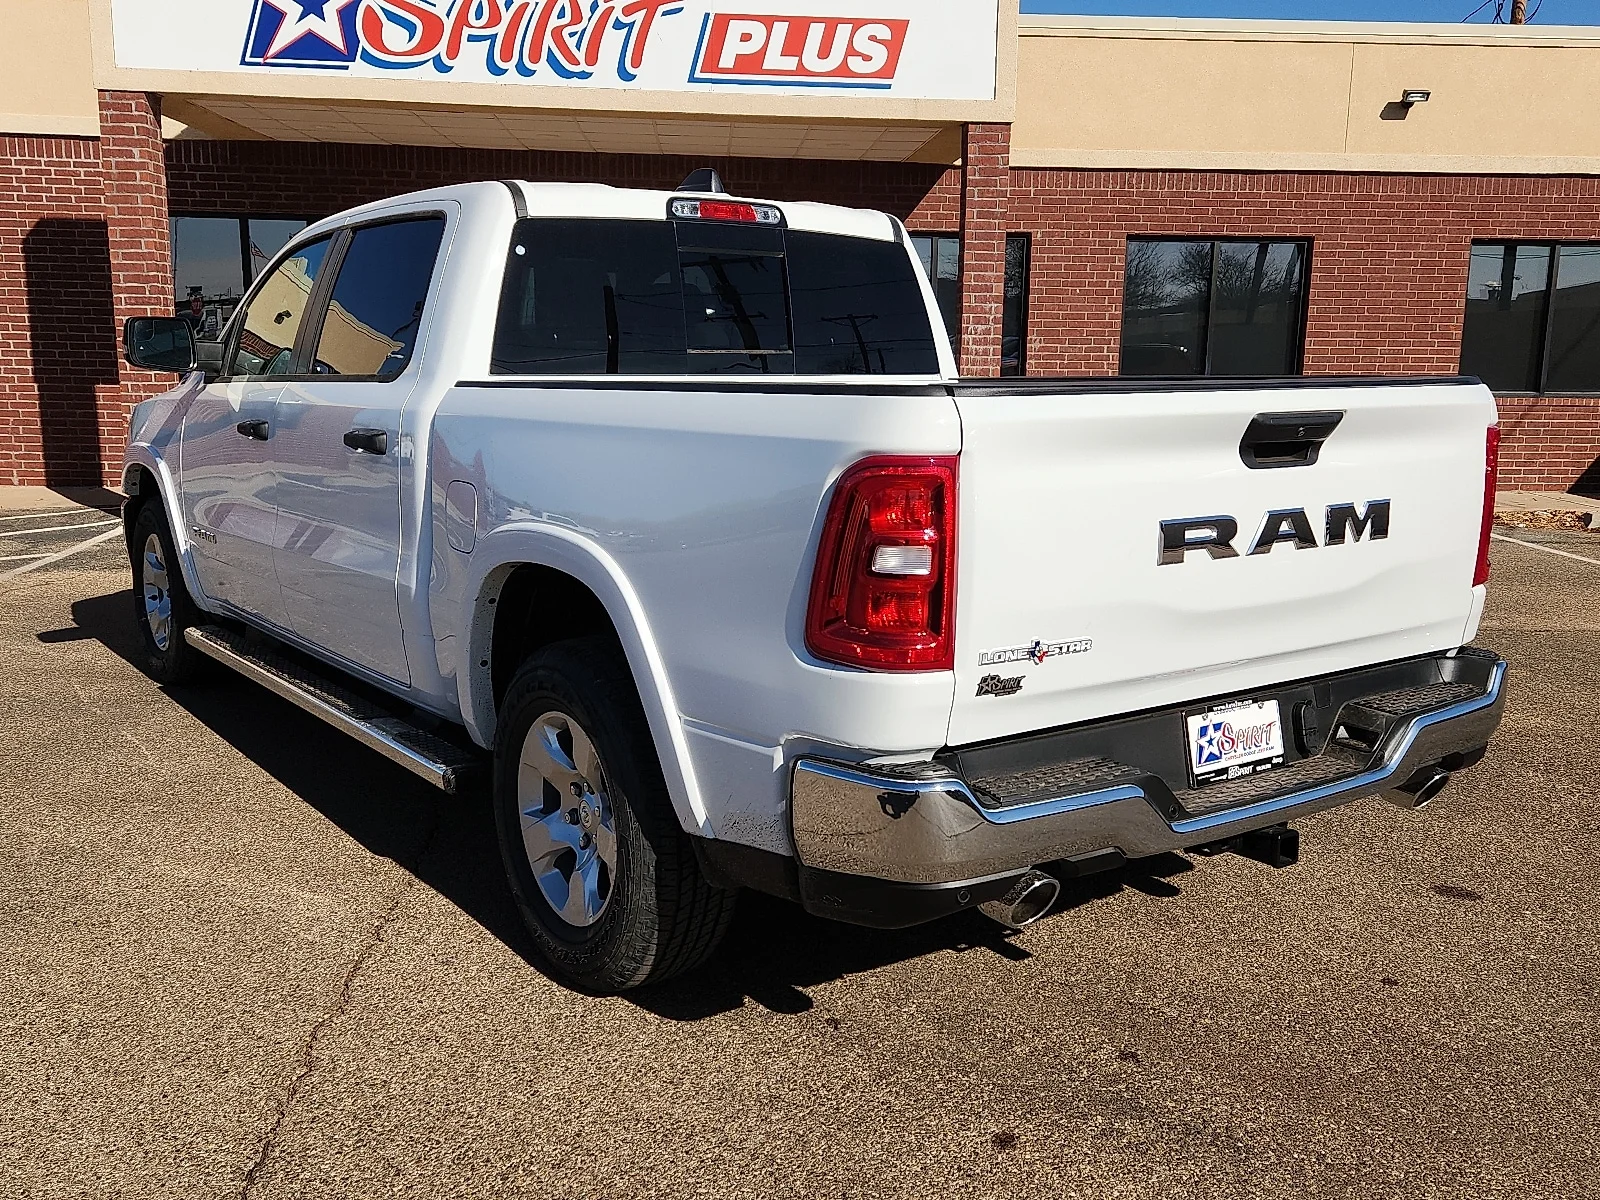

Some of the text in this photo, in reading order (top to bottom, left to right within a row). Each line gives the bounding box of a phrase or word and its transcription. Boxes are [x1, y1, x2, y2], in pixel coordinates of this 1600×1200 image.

[359, 0, 684, 81] SPIRIT
[717, 20, 893, 74] PLUS
[1157, 498, 1391, 566] RAM
[978, 638, 1093, 666] LONE STAR
[1220, 720, 1277, 755] SPIRIT
[1243, 749, 1256, 757] DODGE
